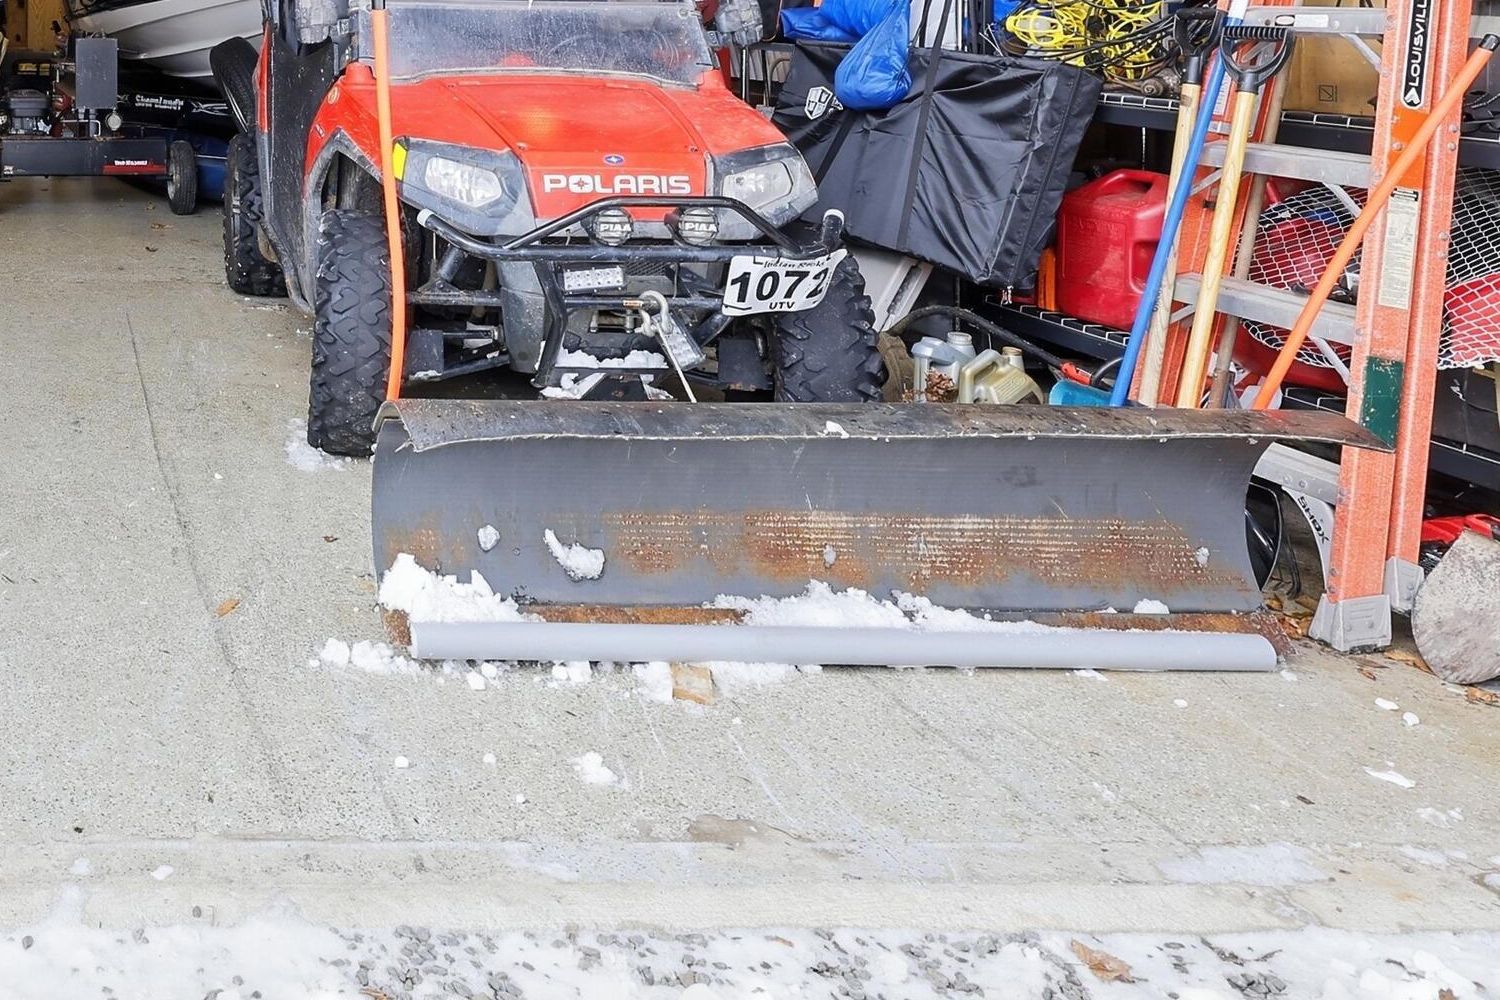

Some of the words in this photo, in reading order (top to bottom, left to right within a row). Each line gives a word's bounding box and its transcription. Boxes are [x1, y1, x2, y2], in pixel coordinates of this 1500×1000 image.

[543, 174, 692, 194] POLARIS
[600, 223, 632, 232] PIAA
[684, 222, 717, 232] PIAA
[730, 267, 830, 303] 1072
[768, 301, 796, 310] UTV
